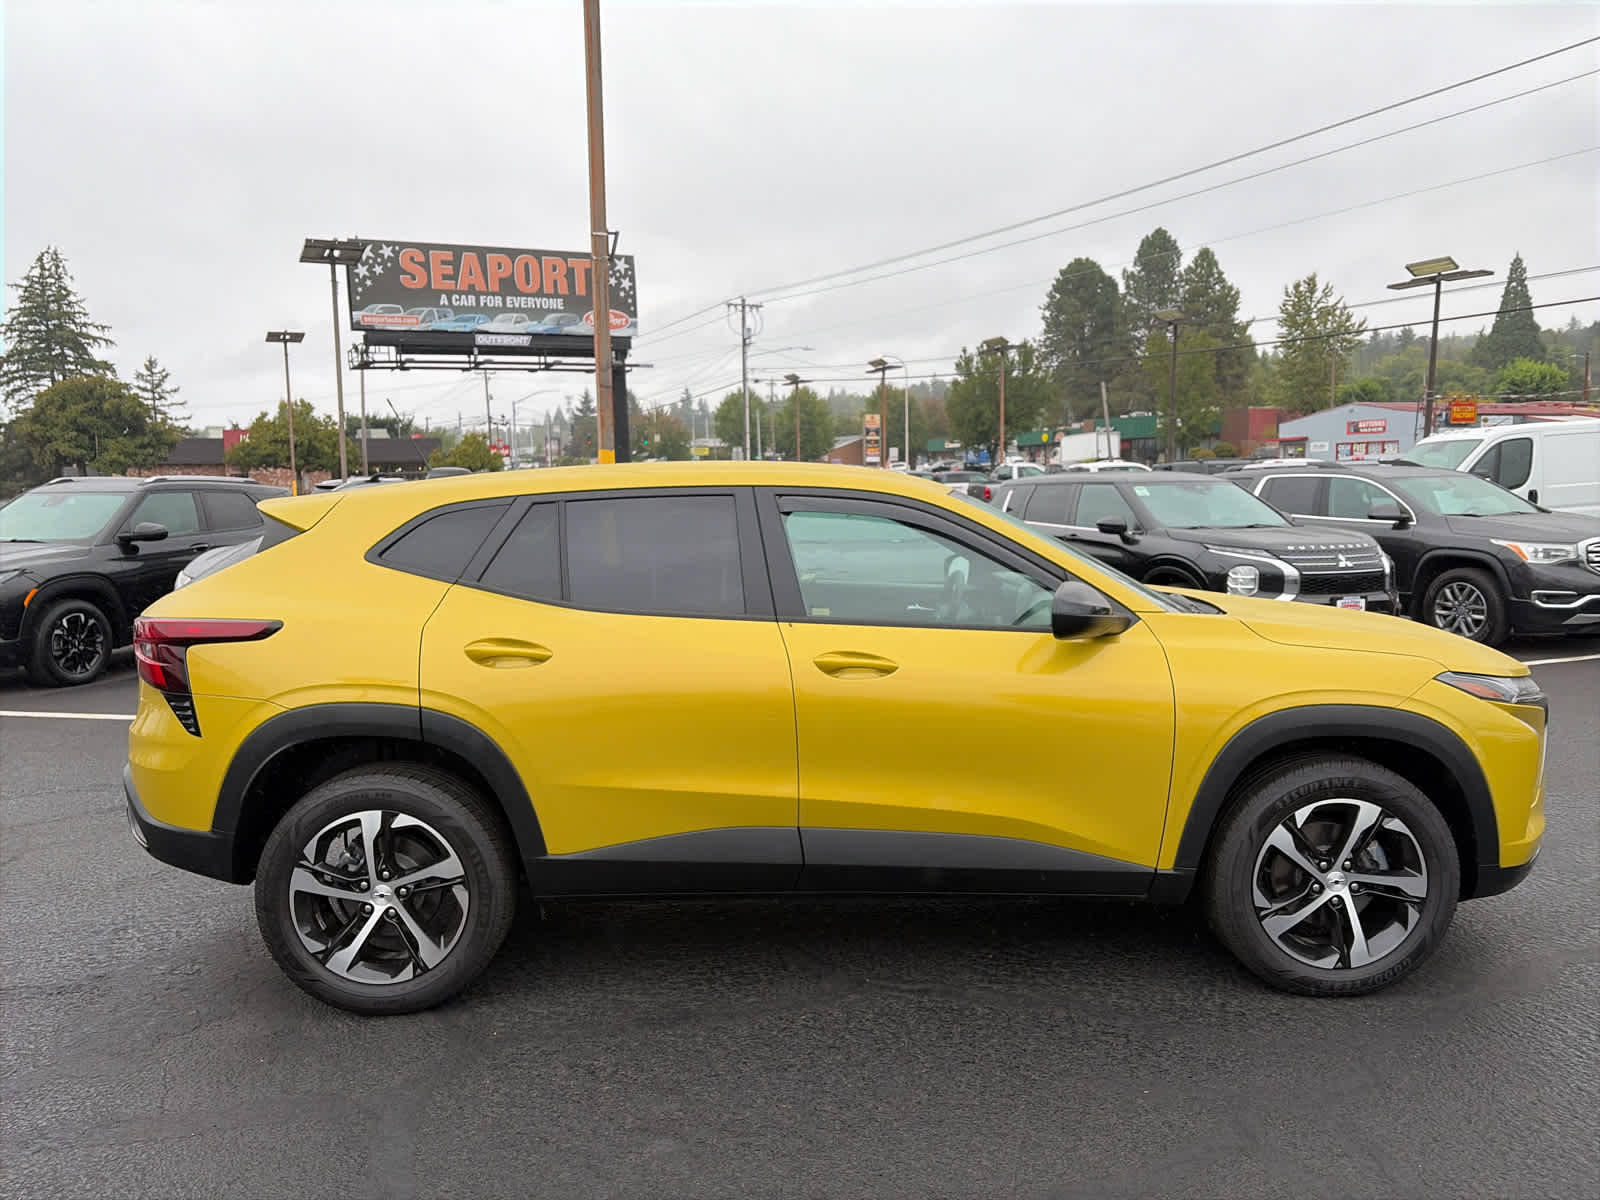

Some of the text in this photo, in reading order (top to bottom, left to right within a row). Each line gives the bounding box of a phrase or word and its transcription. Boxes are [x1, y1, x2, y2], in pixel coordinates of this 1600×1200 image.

[399, 248, 592, 297] SEAPORT
[439, 293, 564, 310] A CAR FOR EVERYONE
